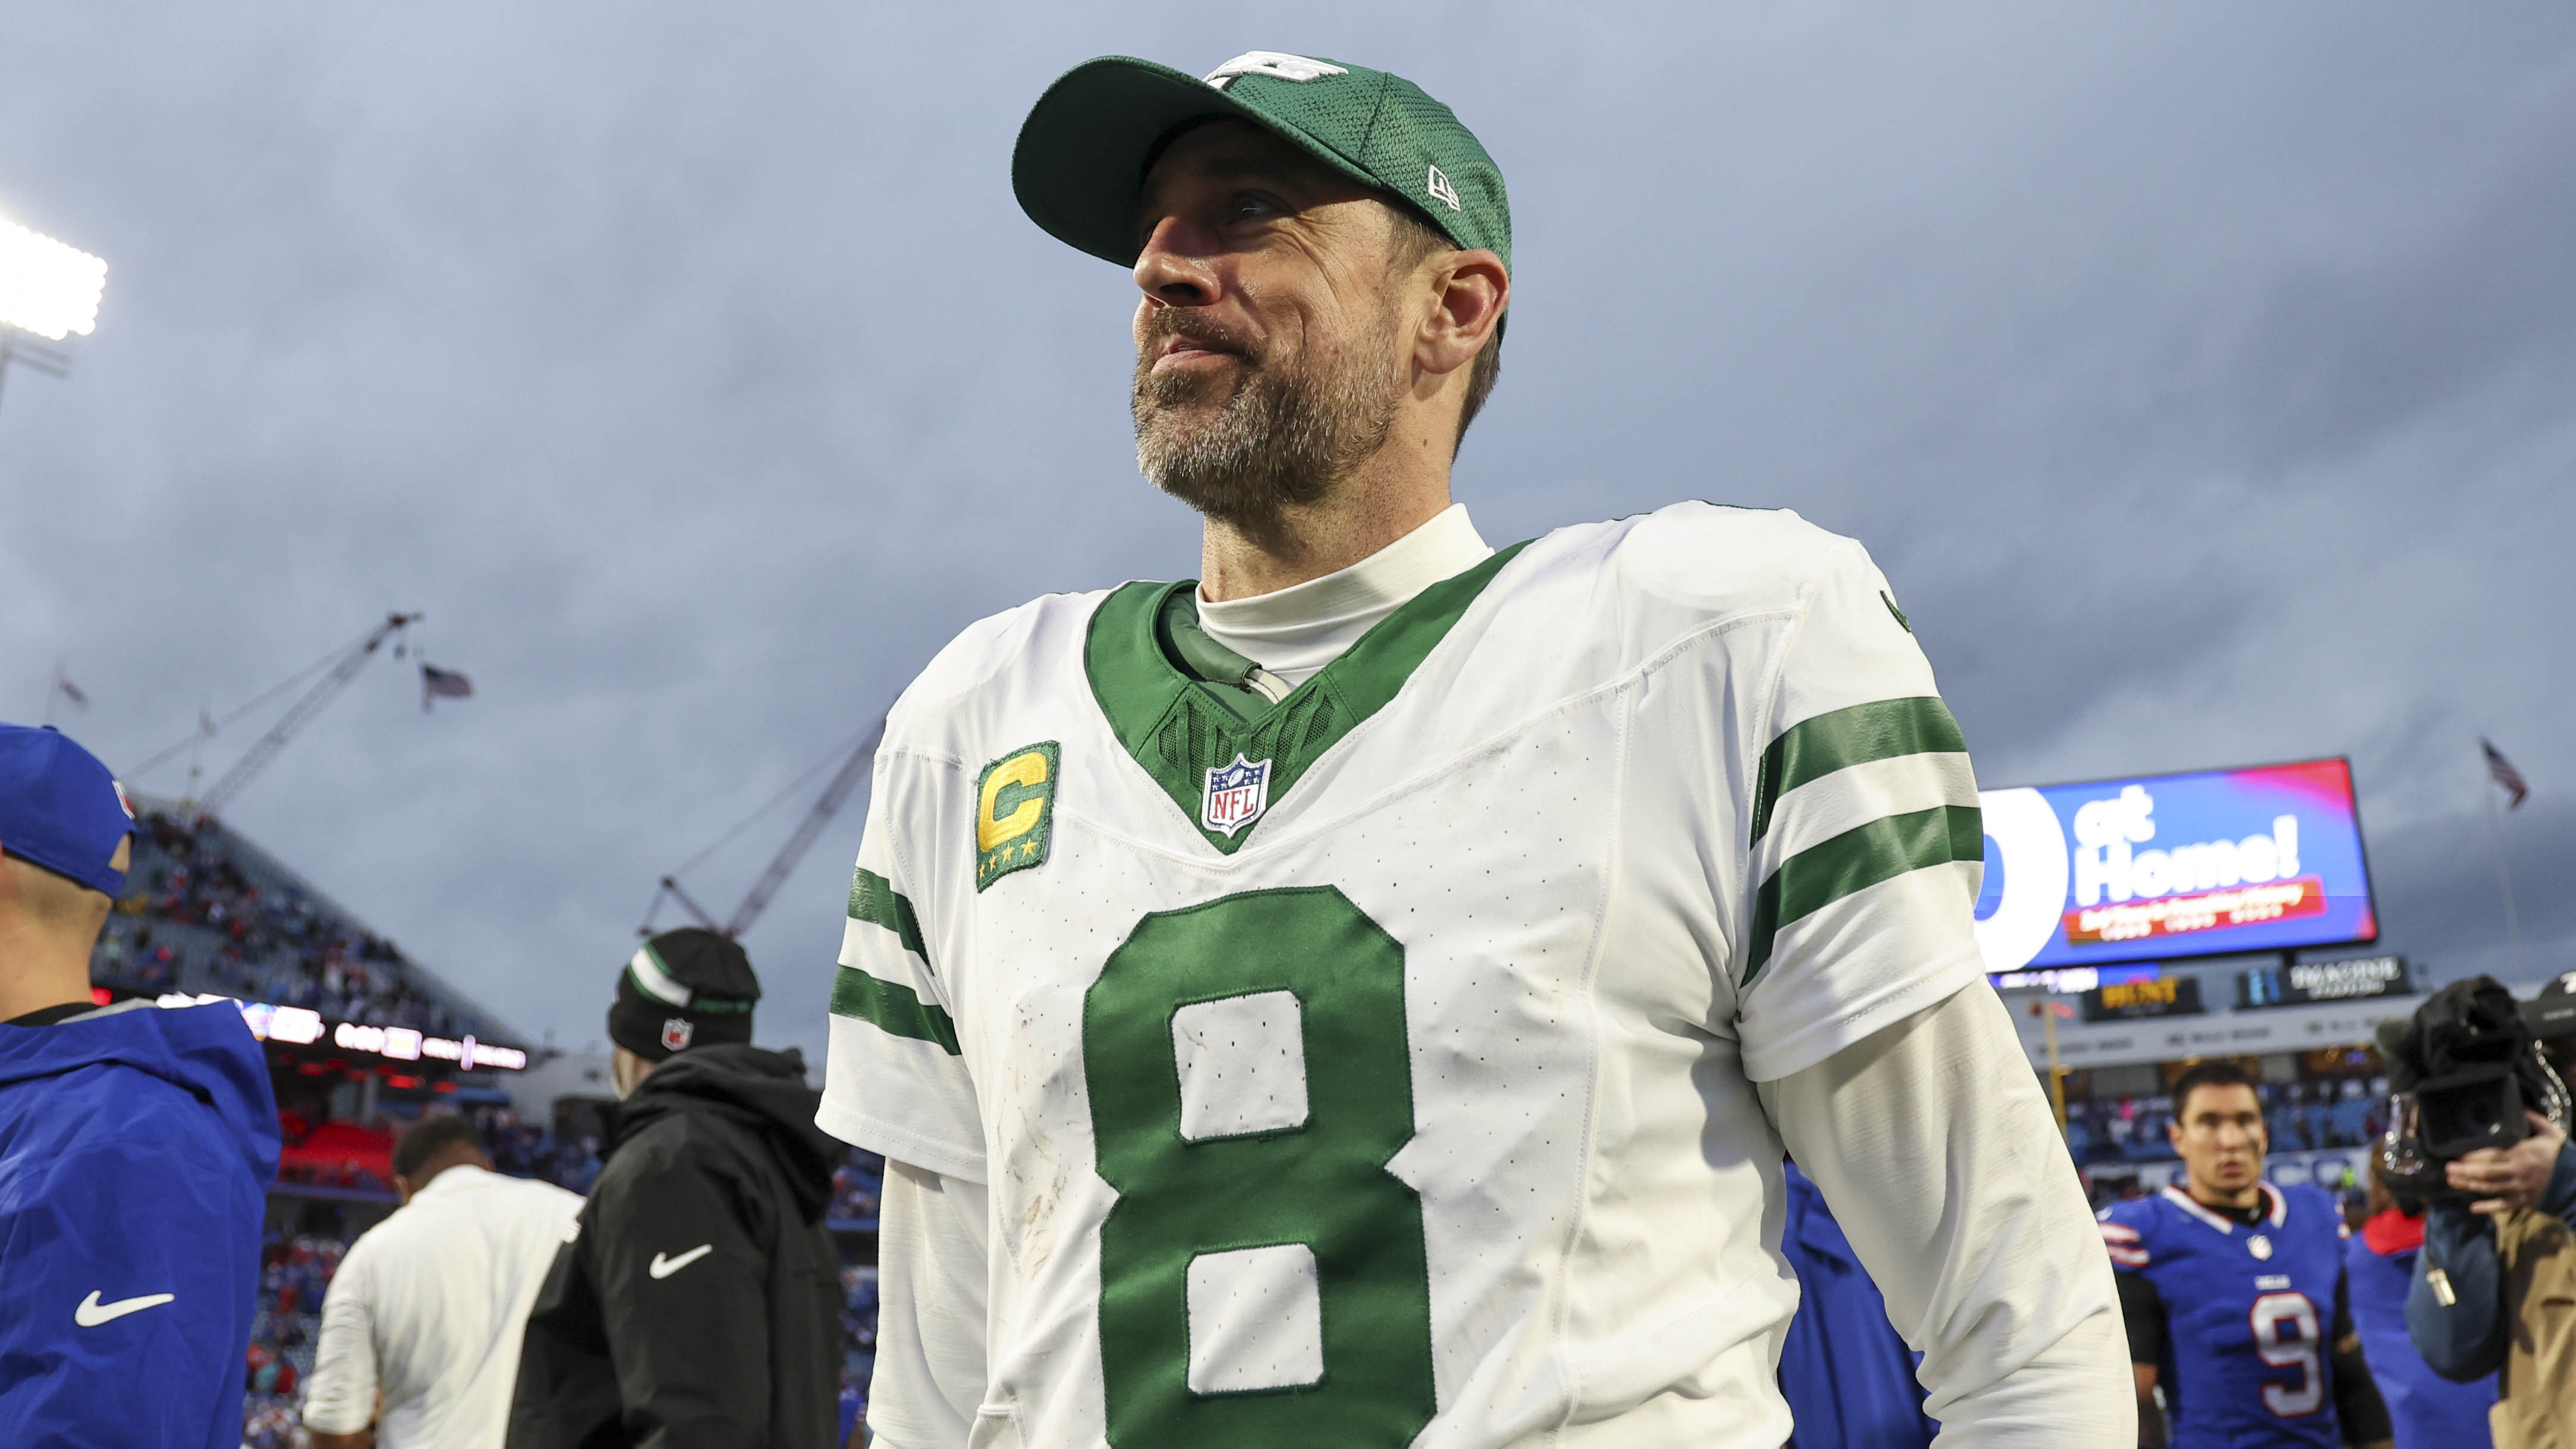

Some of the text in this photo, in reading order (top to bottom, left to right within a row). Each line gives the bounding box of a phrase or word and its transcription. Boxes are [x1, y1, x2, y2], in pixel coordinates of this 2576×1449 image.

[978, 752, 1048, 853] C
[1213, 792, 1254, 821] NFL
[2074, 784, 2156, 848] at
[2074, 815, 2300, 907] Home!
[1081, 884, 1438, 1449] 8
[2249, 1291, 2323, 1418] 9
